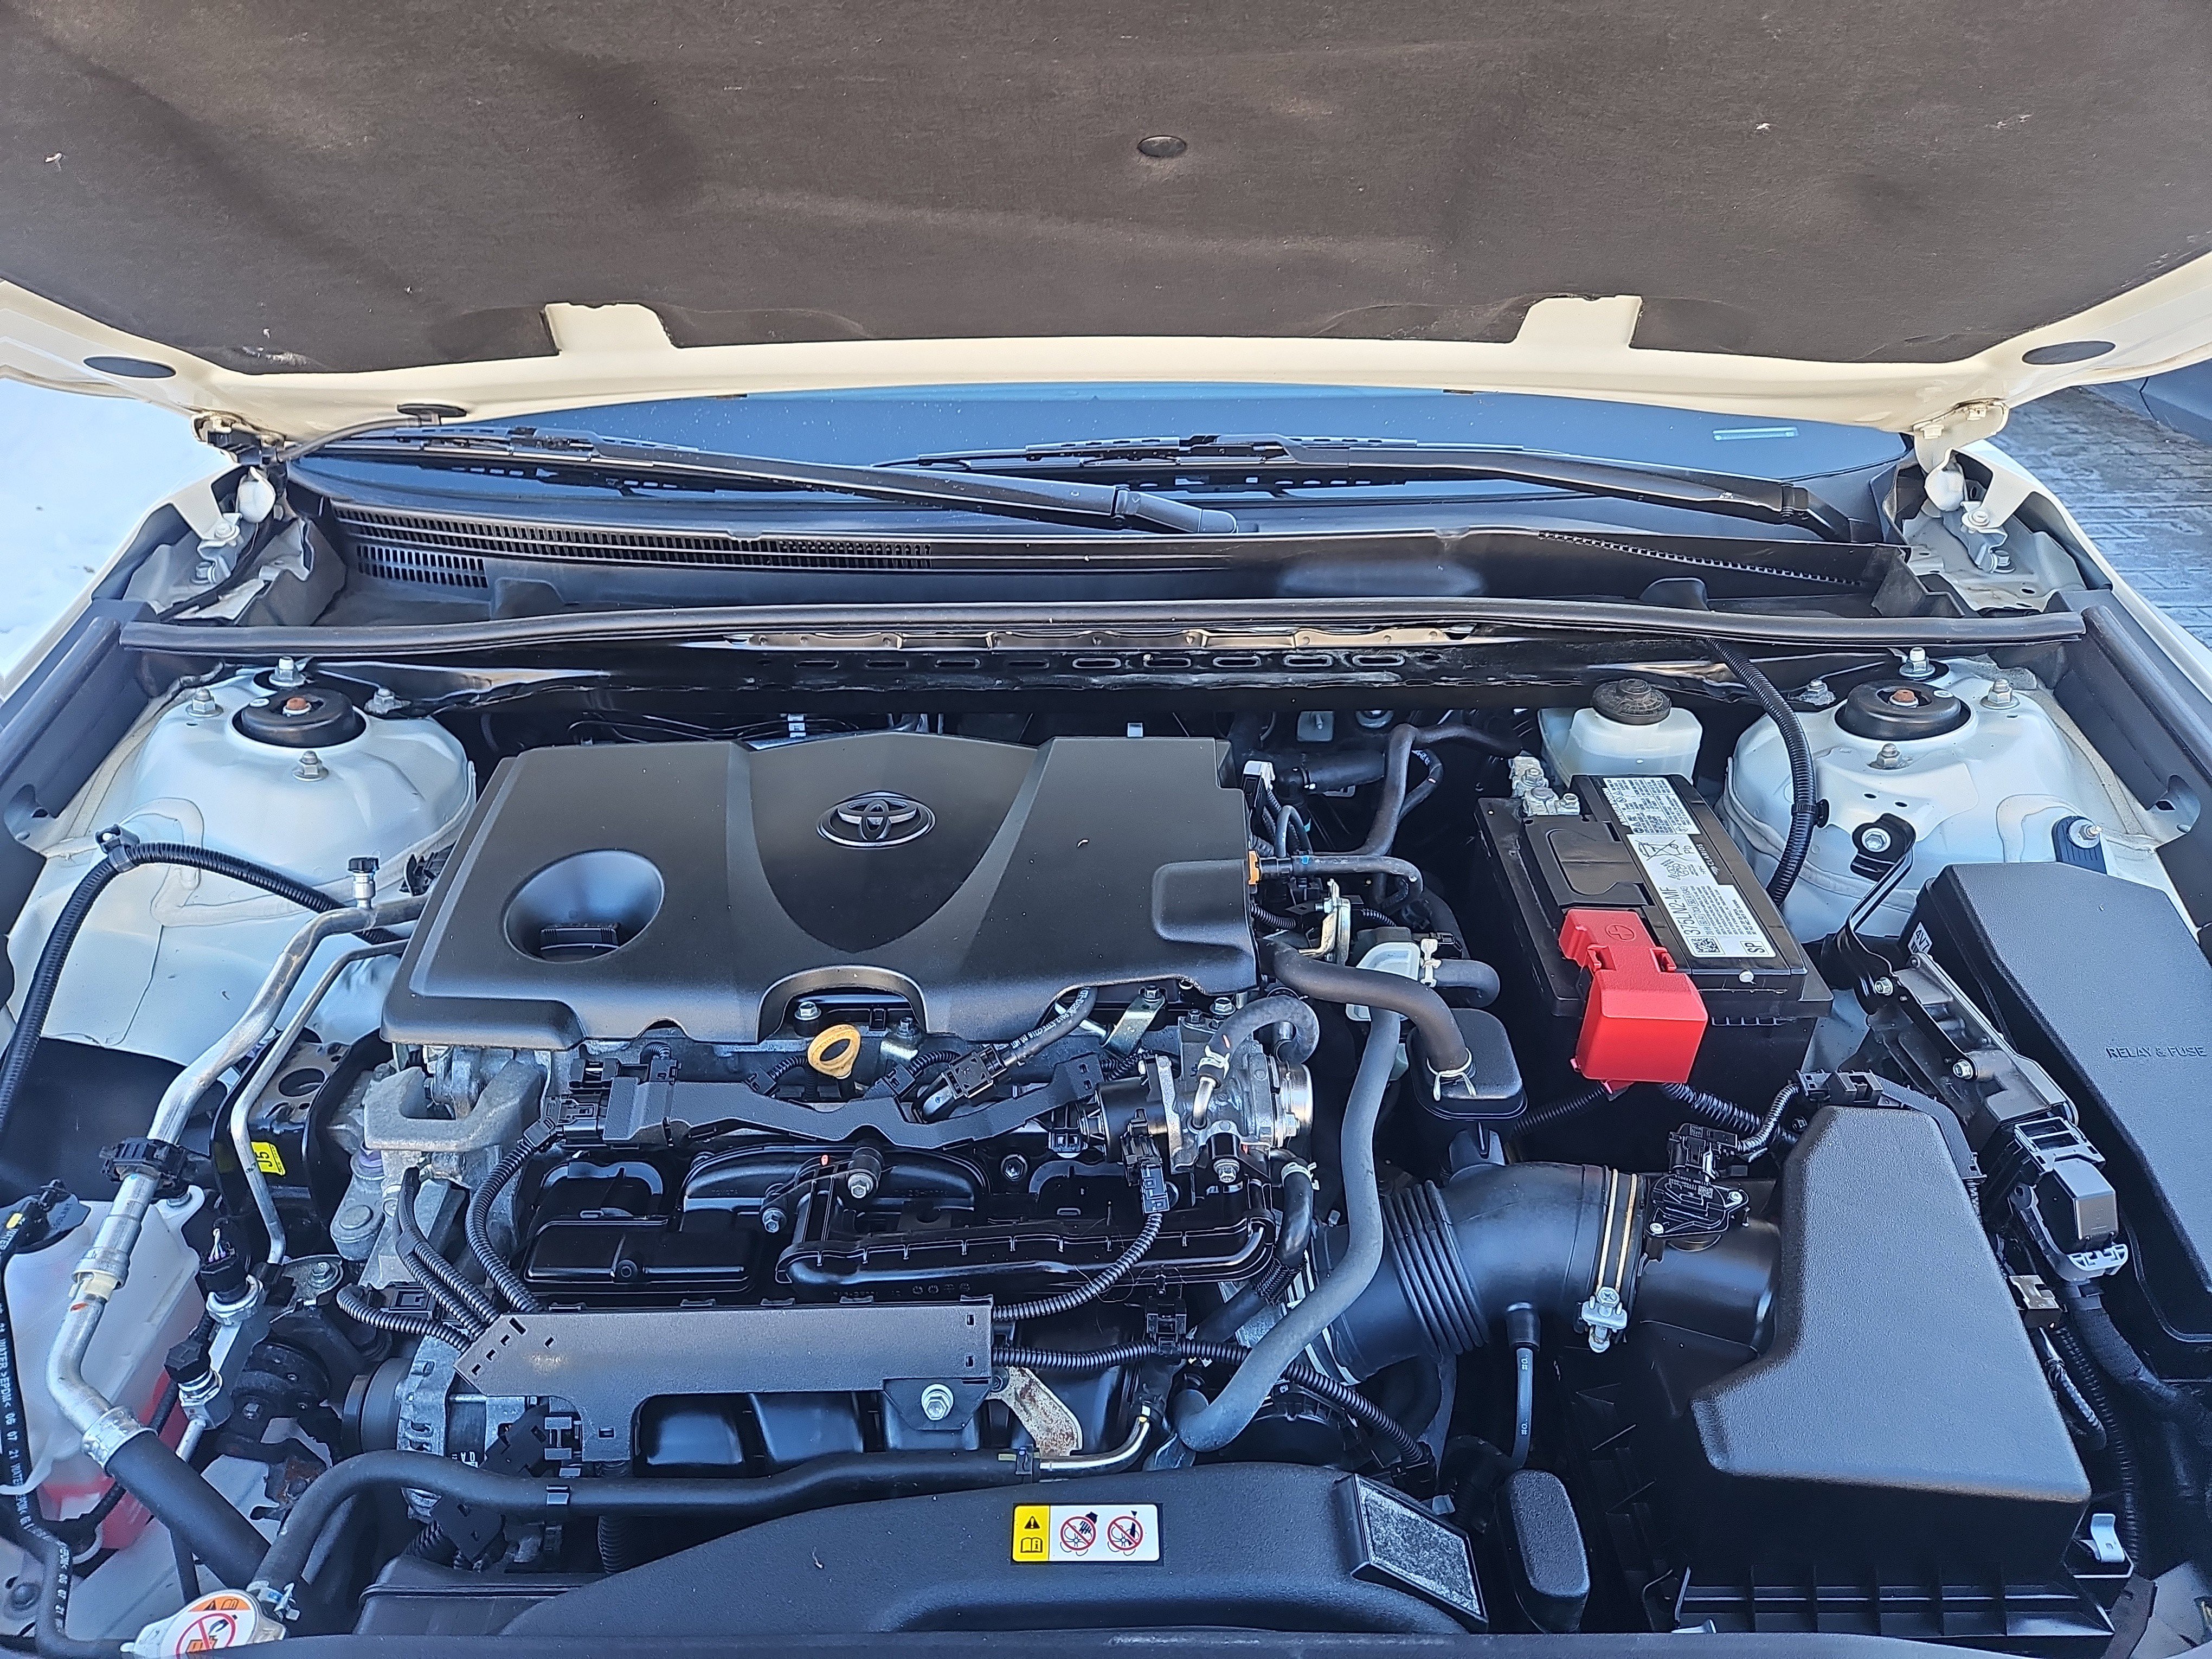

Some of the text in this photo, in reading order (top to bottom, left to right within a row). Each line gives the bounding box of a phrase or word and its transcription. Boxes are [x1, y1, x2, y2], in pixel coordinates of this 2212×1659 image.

[1682, 845, 1695, 854] Pb
[1696, 843, 1715, 866] CLARIOS
[1658, 886, 1702, 935] 375LN2-MF
[1915, 929, 1930, 951] 4V7
[1743, 942, 1766, 953] SP
[2106, 1046, 2208, 1058] RELAY & FUSE
[255, 1152, 273, 1167] J5
[9, 1449, 20, 1459] 21
